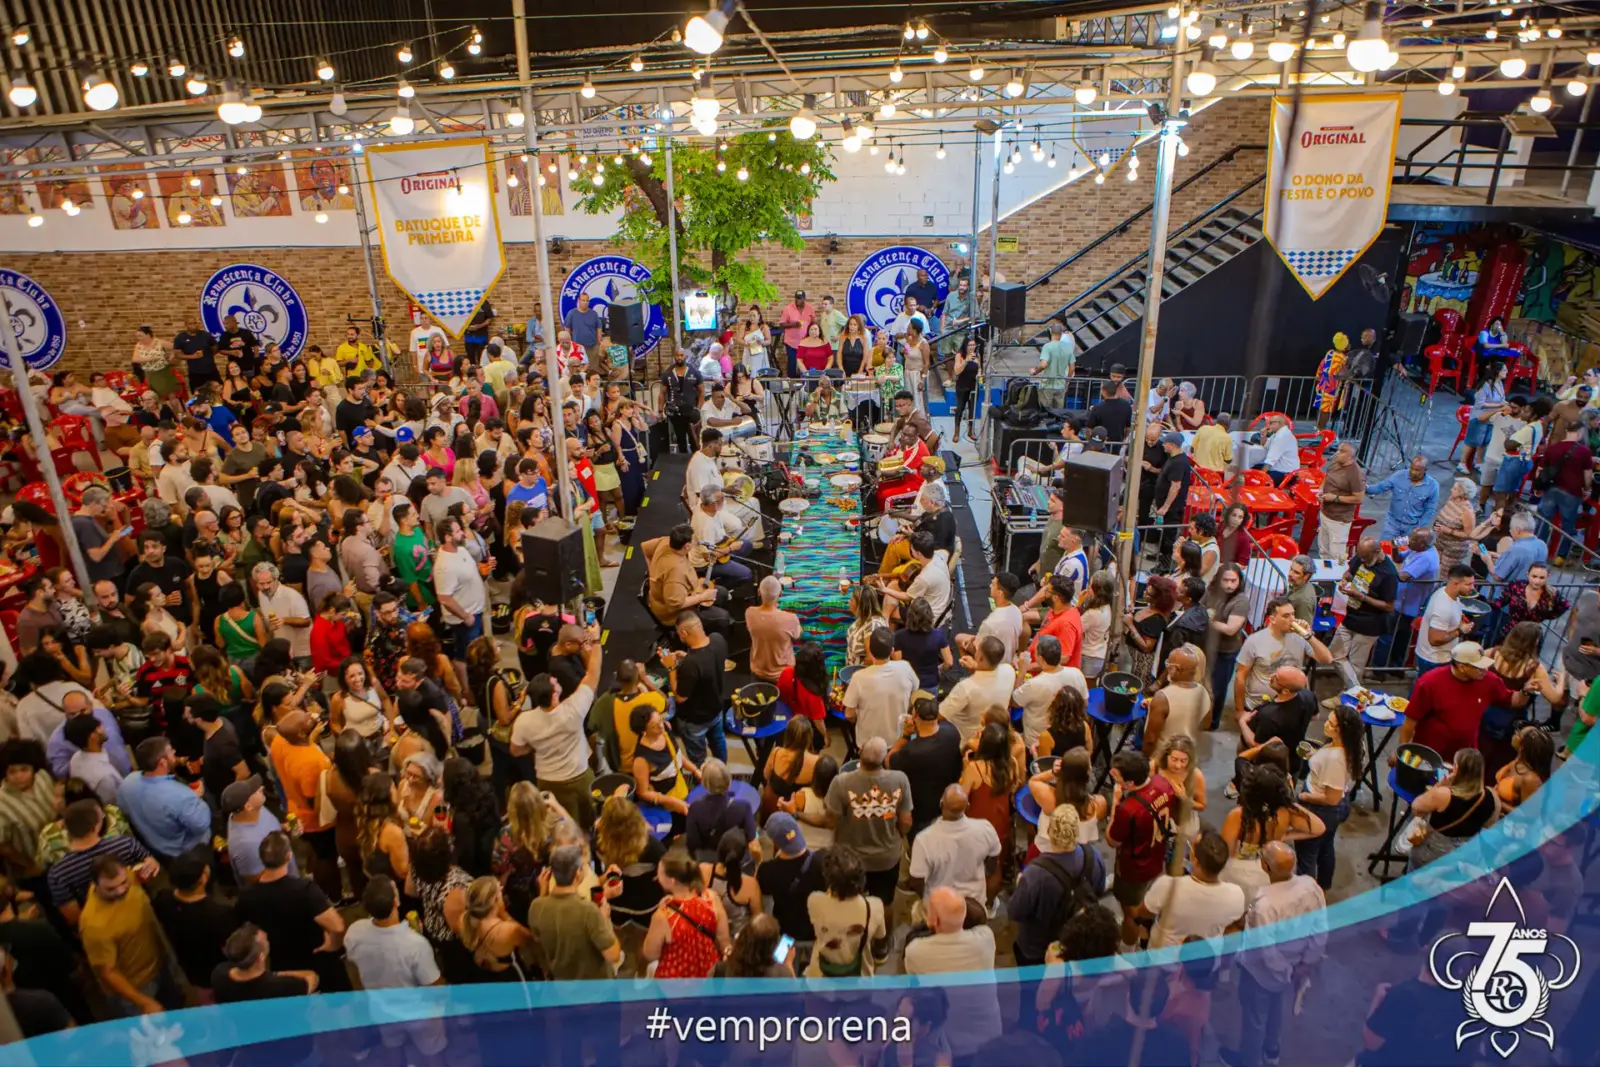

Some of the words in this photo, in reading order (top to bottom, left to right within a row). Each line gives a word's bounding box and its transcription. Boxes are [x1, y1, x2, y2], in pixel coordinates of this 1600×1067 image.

[1301, 131, 1366, 148] ORIGINAL
[401, 177, 460, 194] ORIGINAL
[1292, 174, 1302, 186] O
[1304, 173, 1344, 186] DONO
[1347, 172, 1364, 185] DA
[1279, 188, 1313, 201] FESTA
[1326, 188, 1336, 200] O
[1340, 186, 1374, 200] POVO
[395, 217, 460, 233] BATUQUE
[464, 214, 481, 227] DE
[408, 230, 475, 246] PRIMEIRA
[852, 251, 919, 290] Renascença
[920, 255, 948, 289] Clube
[203, 269, 262, 308] Renascença
[263, 273, 295, 306] Clube
[563, 261, 627, 300] Renascença
[16, 277, 51, 310] Clube
